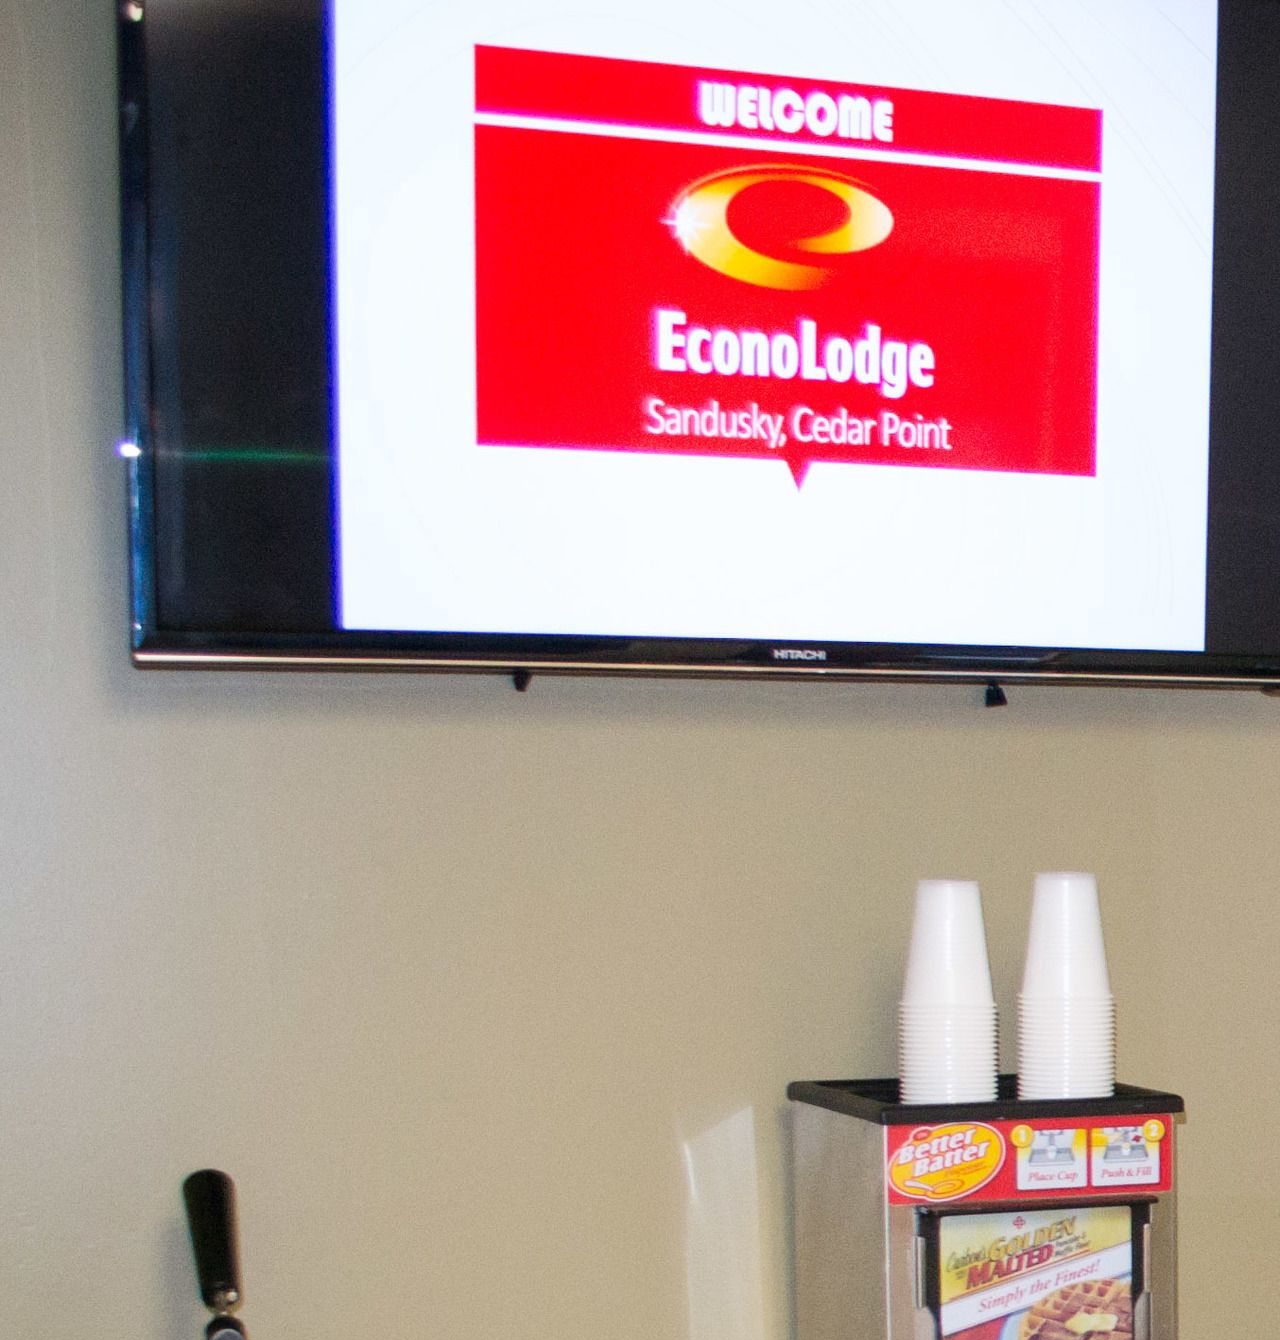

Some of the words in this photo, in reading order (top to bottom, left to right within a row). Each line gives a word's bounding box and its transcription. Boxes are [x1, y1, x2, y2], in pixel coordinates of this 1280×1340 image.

[698, 80, 894, 142] WELCOME
[656, 308, 936, 399] EconoLodge
[645, 397, 788, 450] Sandusky,
[793, 406, 877, 446] Cedar
[880, 411, 953, 450] Point
[773, 649, 827, 660] HITACHI
[898, 1128, 977, 1165] Better
[913, 1141, 991, 1177] Batter
[1028, 1170, 1054, 1183] Place
[1057, 1170, 1078, 1182] Cup
[1100, 1168, 1125, 1178] Push
[1126, 1168, 1133, 1177] &
[1136, 1166, 1152, 1177] Fill
[988, 1215, 1077, 1262] GOLDEN
[966, 1243, 1054, 1290] MALTED
[979, 1286, 1027, 1313] Simply
[1030, 1279, 1052, 1294] the
[1055, 1259, 1101, 1287] Finest!
